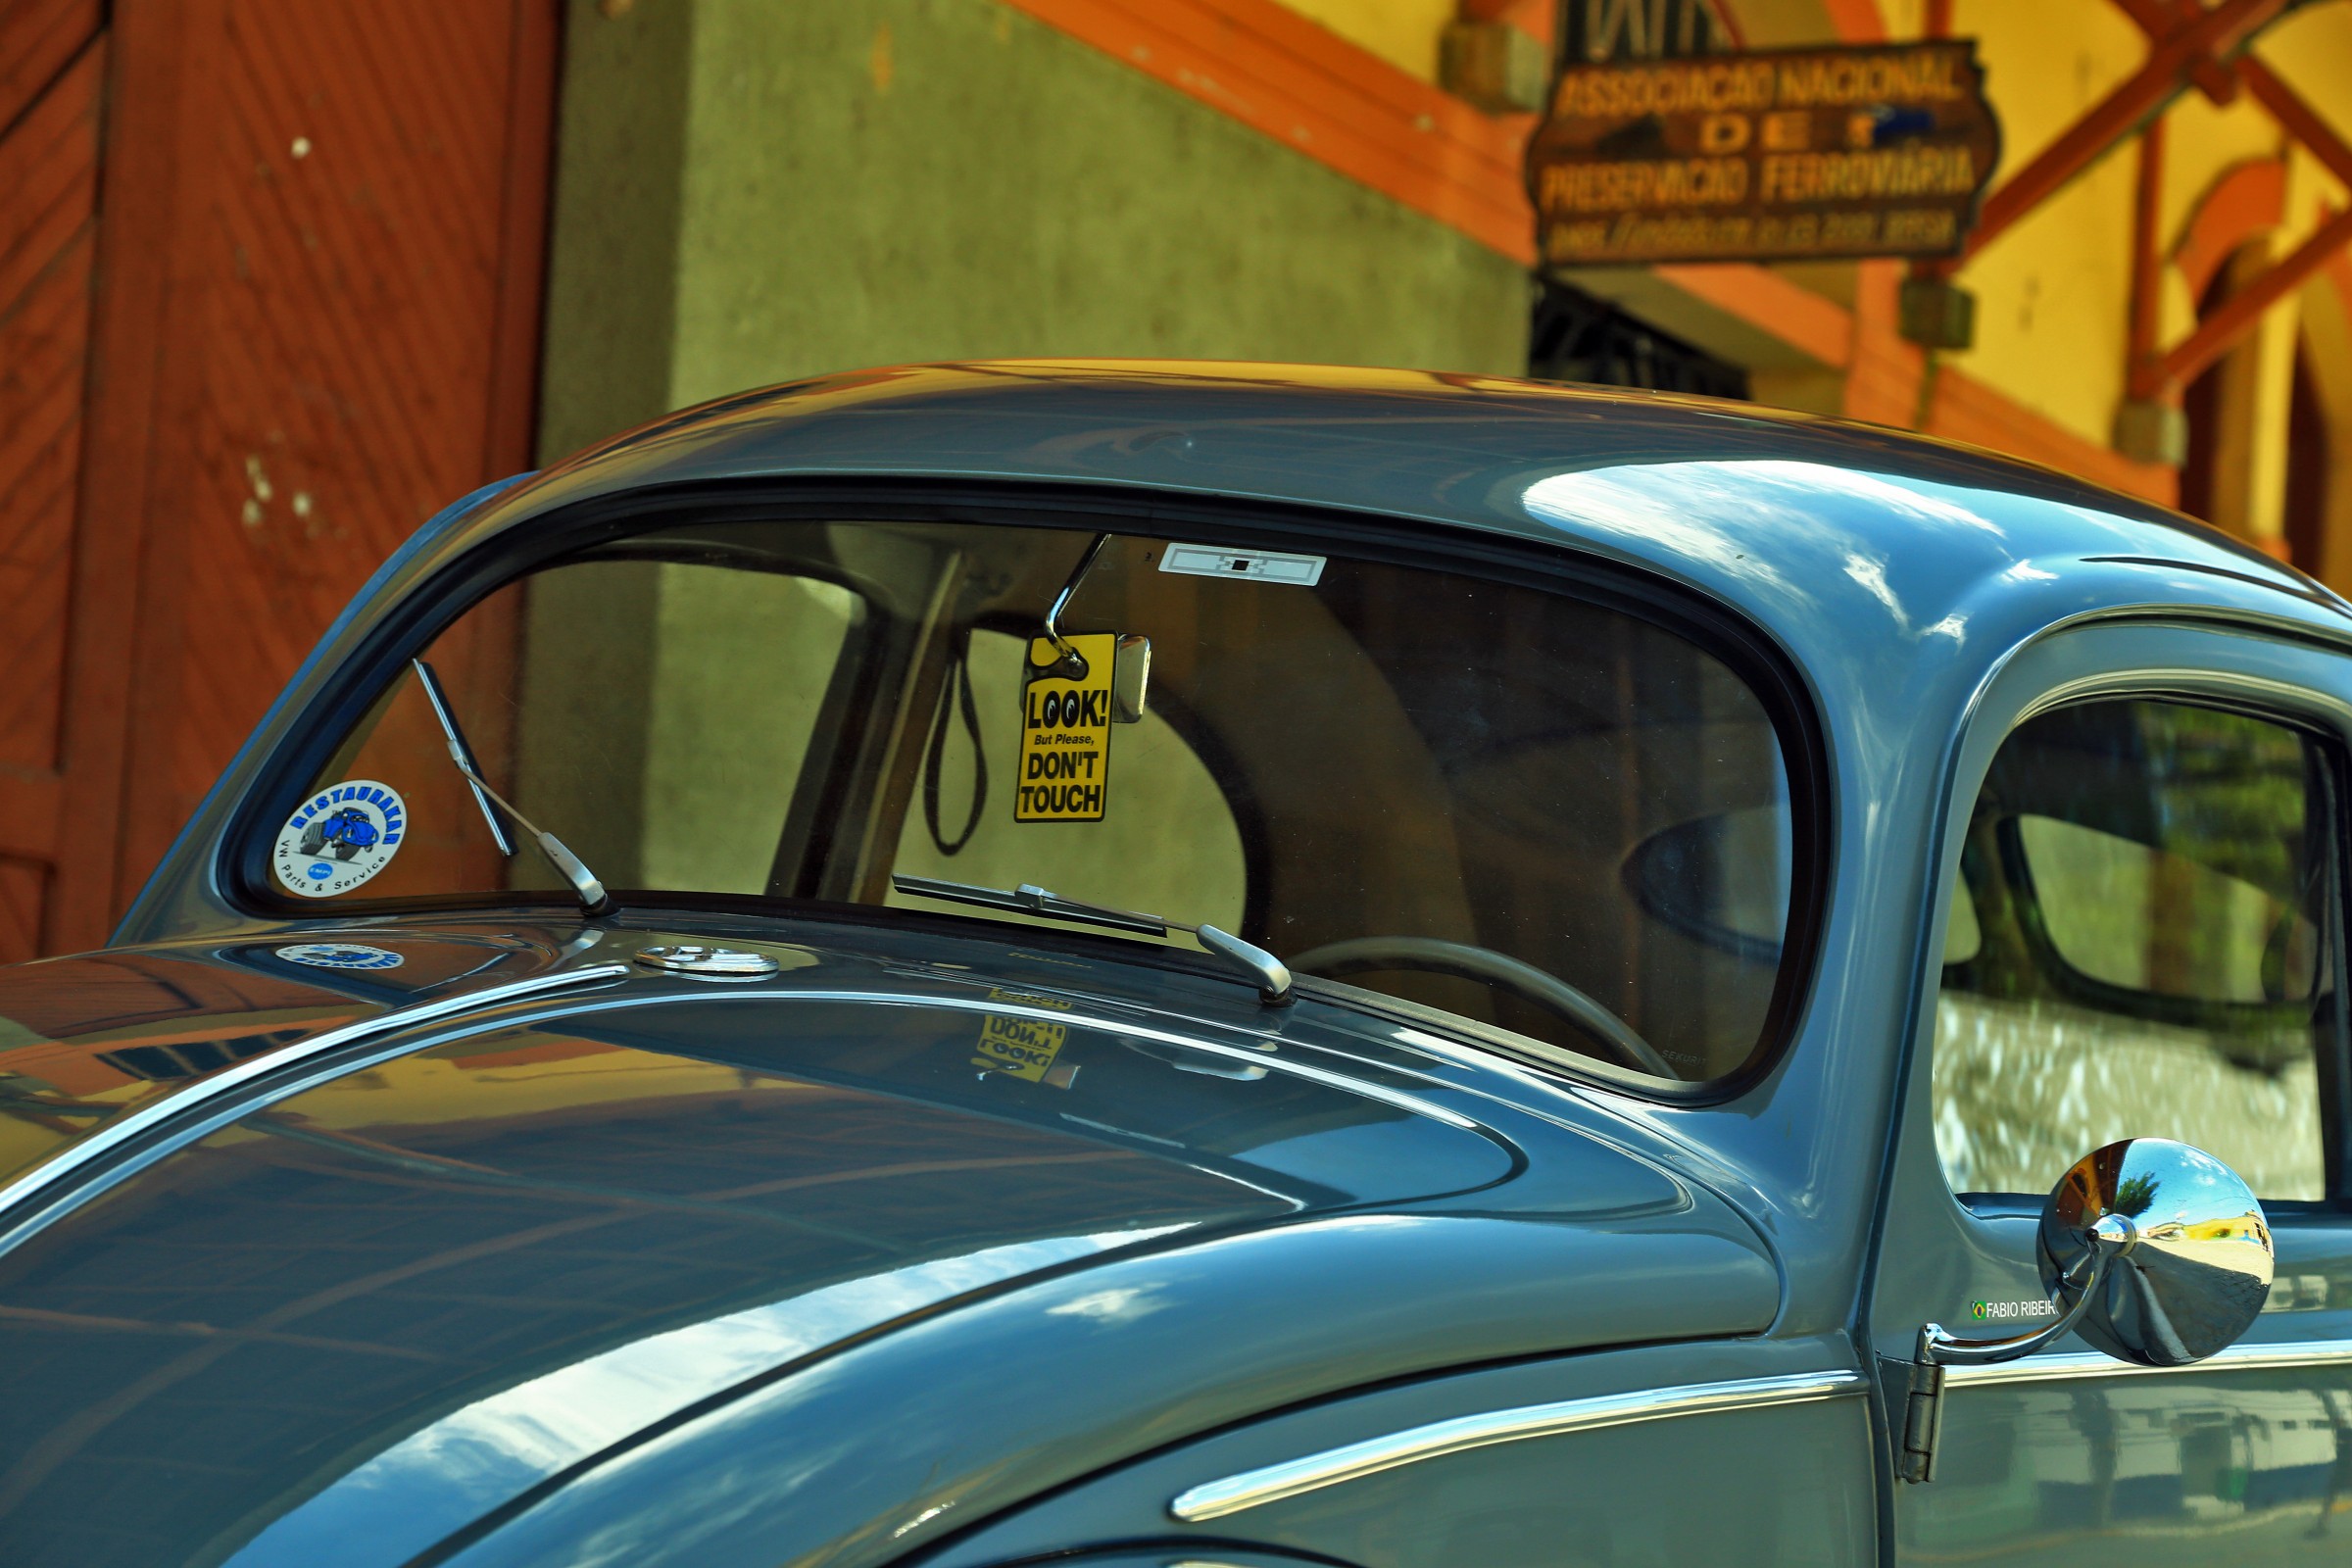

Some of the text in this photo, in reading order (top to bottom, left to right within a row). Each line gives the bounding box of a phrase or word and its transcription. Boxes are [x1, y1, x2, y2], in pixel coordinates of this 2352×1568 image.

[1027, 689, 1108, 729] LOOK!
[1034, 733, 1095, 747] But Please,
[1027, 751, 1099, 780] DON'T
[1020, 784, 1101, 813] TOUCH
[281, 864, 307, 889] Parts
[315, 883, 323, 892] &
[333, 856, 385, 890] Service
[1985, 1299, 2060, 1318] FABIO RIBEIR
